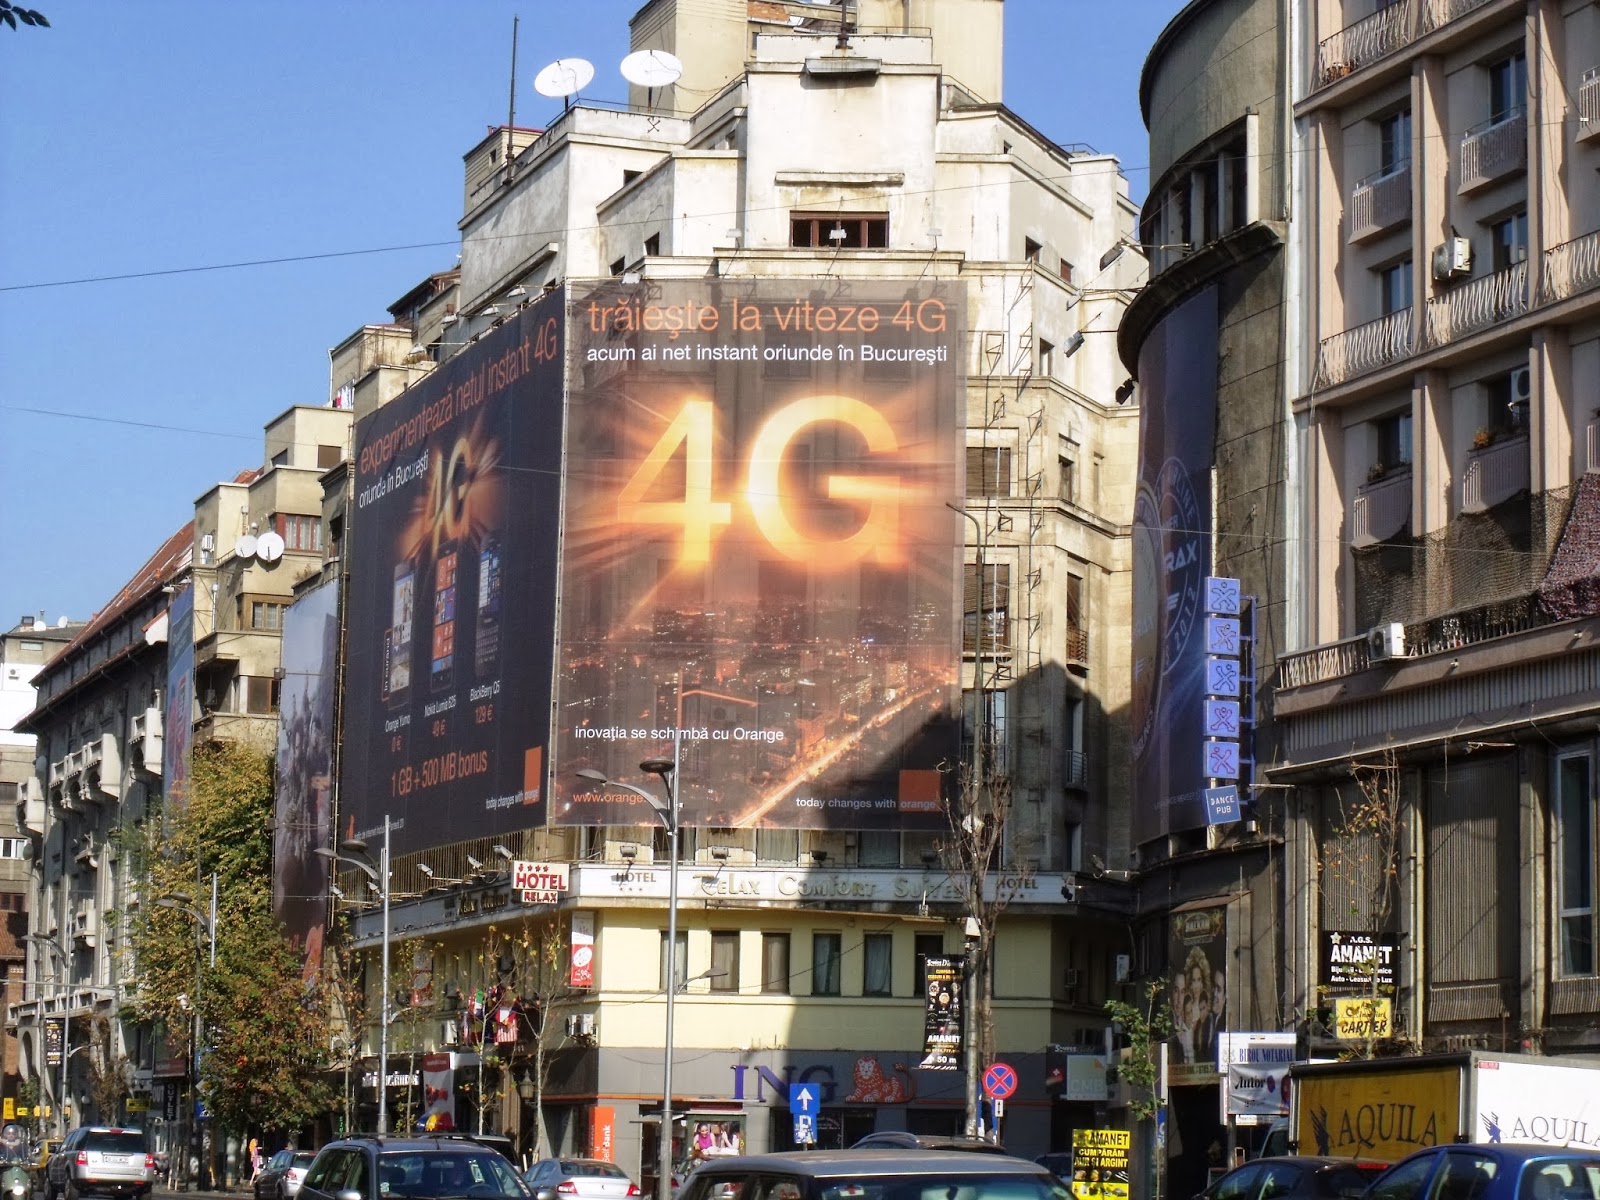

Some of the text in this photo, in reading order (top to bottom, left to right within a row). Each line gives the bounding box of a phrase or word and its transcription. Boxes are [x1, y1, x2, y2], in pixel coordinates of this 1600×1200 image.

[732, 298, 761, 332] la
[773, 298, 880, 332] viteze
[892, 299, 947, 332] 4G
[587, 346, 636, 361] acum
[641, 345, 657, 361] ai
[662, 346, 691, 361] net
[696, 345, 758, 361] instant
[763, 345, 833, 361] oriunde
[837, 344, 854, 361] în
[360, 317, 557, 475] experimentează netul instant 4G
[616, 395, 912, 570] 4G
[359, 476, 387, 508] oriunde
[424, 437, 473, 556] 4G
[630, 730, 648, 740] se
[712, 730, 729, 741] cu
[733, 727, 784, 743] Orange
[391, 749, 487, 797] 1 GB + 500 MB bonus
[485, 796, 497, 810] today
[498, 796, 514, 808] changes
[796, 797, 897, 811] today changes with
[901, 799, 937, 810] orange
[1210, 795, 1235, 806] DANCE
[1216, 805, 1232, 814] PUB
[515, 871, 567, 890] HOTEL
[616, 872, 656, 883] HOTEL
[996, 877, 1039, 890] HOTEL
[524, 890, 558, 903] RELAX
[1330, 945, 1393, 963] AMANET
[1331, 975, 1345, 983] Auto
[927, 1034, 961, 1043] AMANET
[936, 1056, 948, 1064] 50
[730, 1063, 838, 1103] ING
[167, 1083, 175, 1120] OUTLET
[1337, 1103, 1438, 1150] AQUILA
[1089, 1132, 1128, 1146] AMANET
[1100, 1158, 1128, 1168] ARGINT
